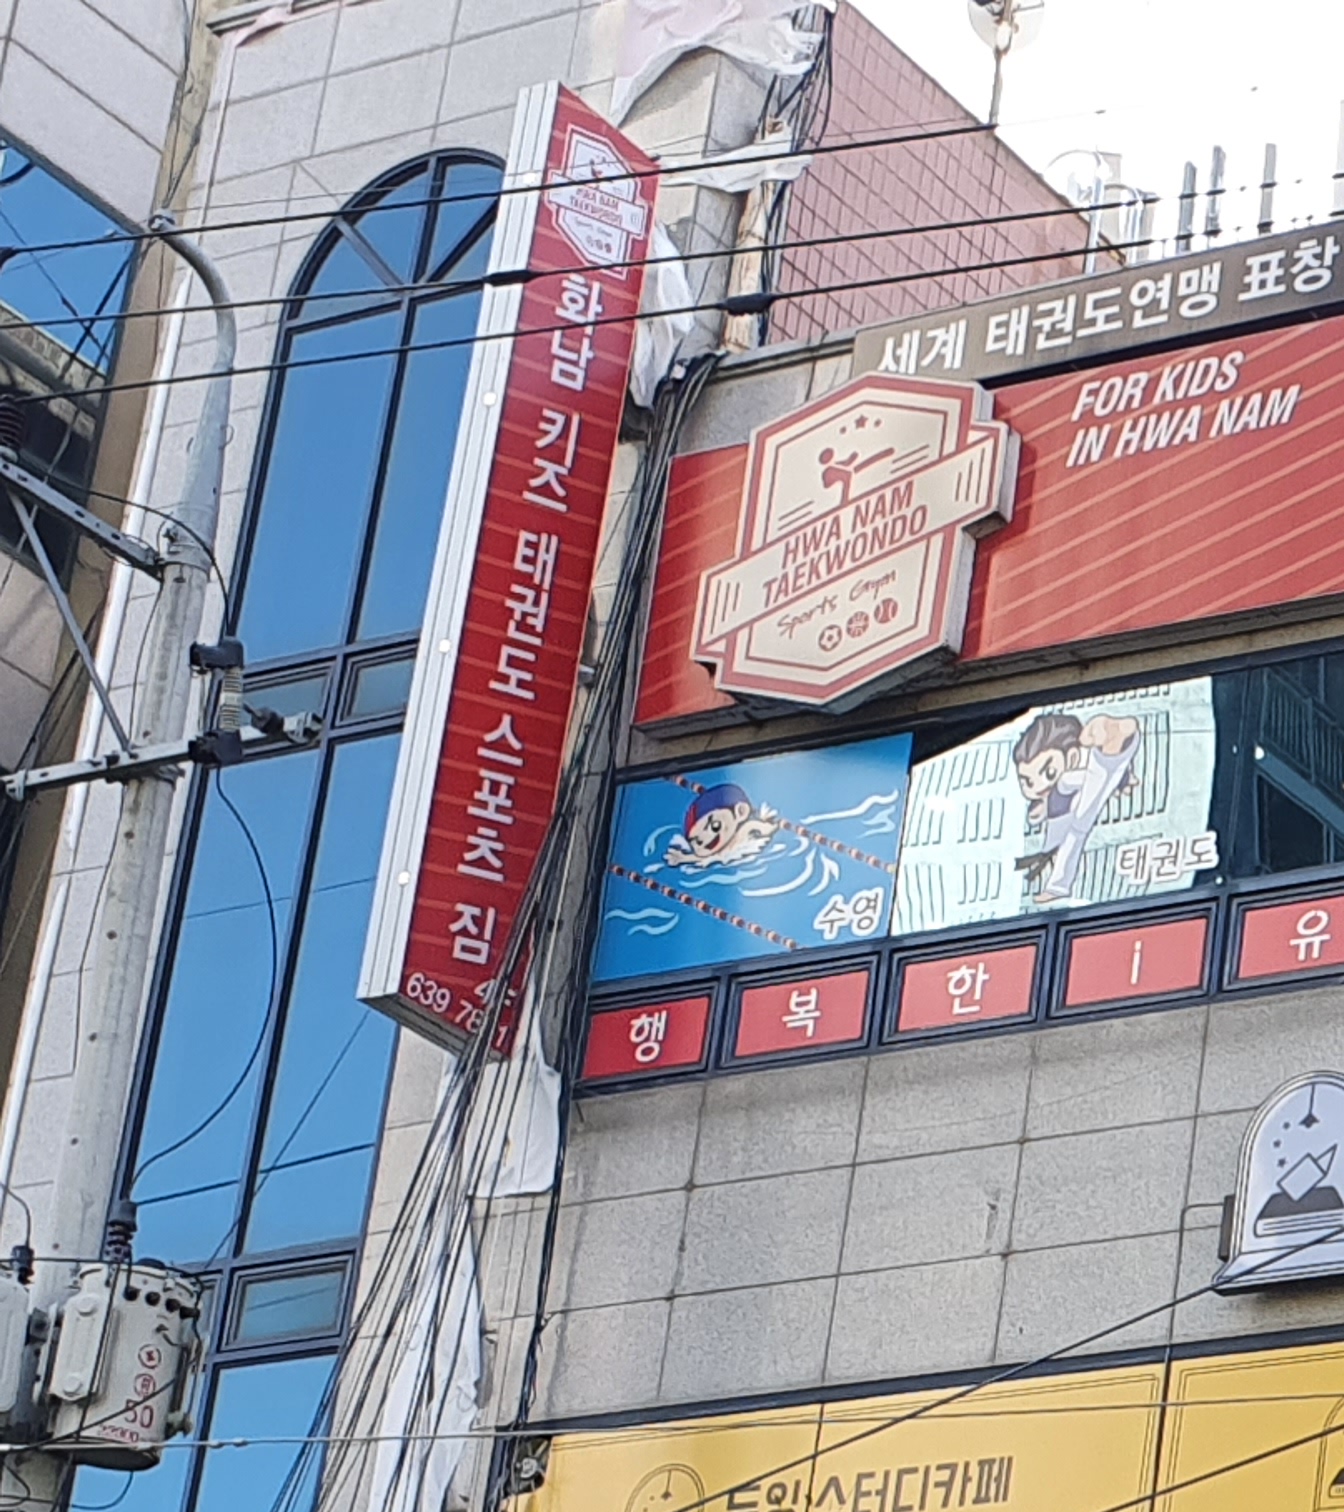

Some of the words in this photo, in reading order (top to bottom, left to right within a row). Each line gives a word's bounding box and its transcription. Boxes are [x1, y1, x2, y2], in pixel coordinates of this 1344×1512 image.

[552, 275, 605, 392] 화남
[877, 319, 967, 376] 세계
[984, 267, 1223, 357] 태권도연맹
[1239, 234, 1342, 301] 표창
[1066, 426, 1108, 469] IN
[1113, 402, 1202, 459] HWA
[1209, 384, 1301, 438] NAM
[1070, 370, 1149, 423] FOR
[1154, 351, 1245, 403] KIDS
[521, 409, 582, 515] 키즈
[763, 504, 928, 608] TAEKWONDO
[781, 515, 842, 570] HWA
[851, 480, 914, 534] NAM
[488, 531, 560, 701] 태권도
[456, 715, 525, 885] 스포츠
[1115, 832, 1219, 884] 태권도
[447, 902, 496, 966] 짐
[813, 887, 885, 939] 수영
[406, 972, 450, 1014] 639
